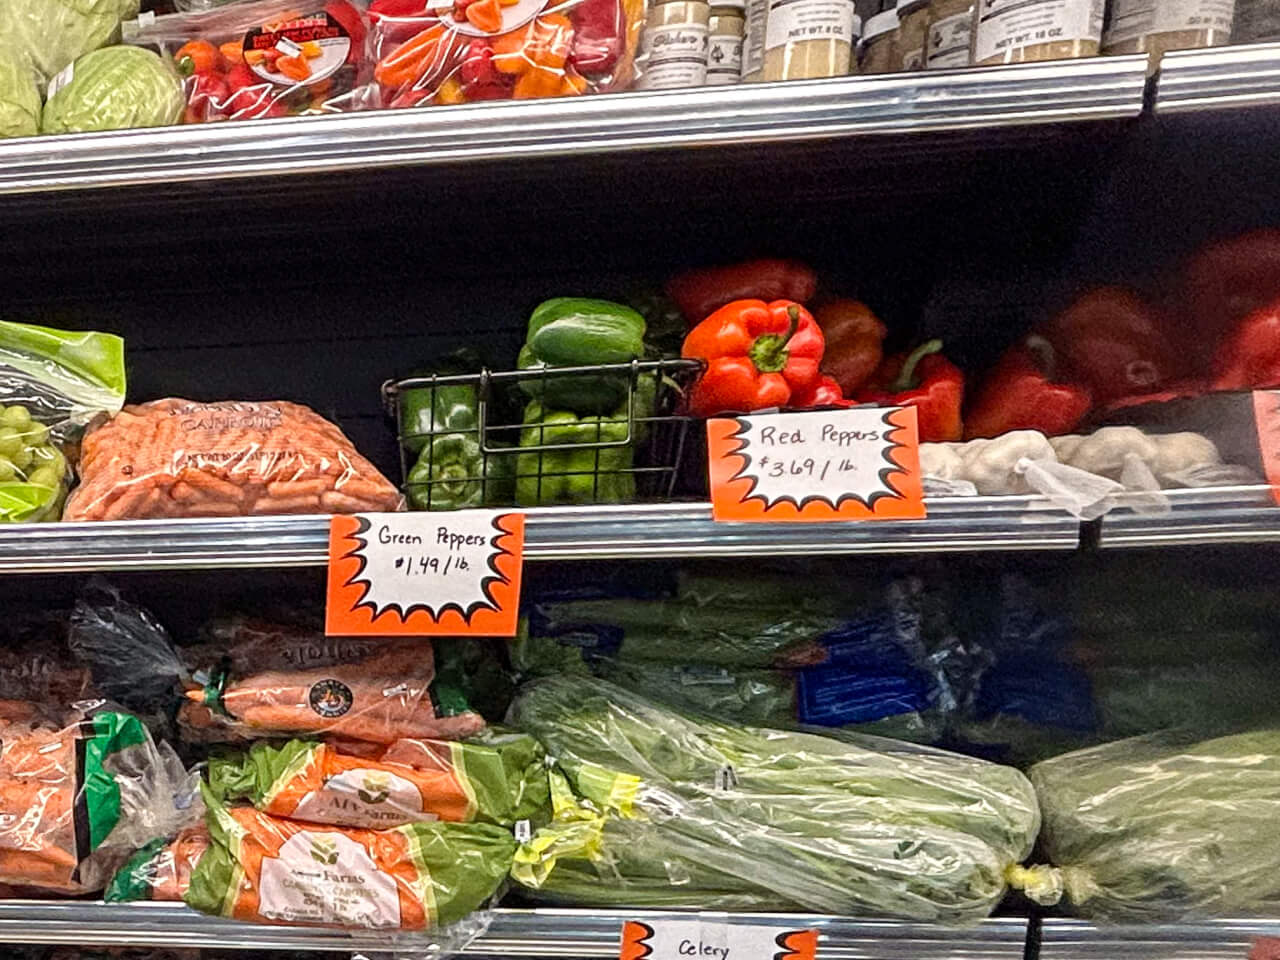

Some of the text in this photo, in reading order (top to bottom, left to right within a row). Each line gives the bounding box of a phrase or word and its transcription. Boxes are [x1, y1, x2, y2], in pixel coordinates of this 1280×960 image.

[761, 424, 880, 447] Red Peppers
[379, 525, 486, 550] Green Peppers
